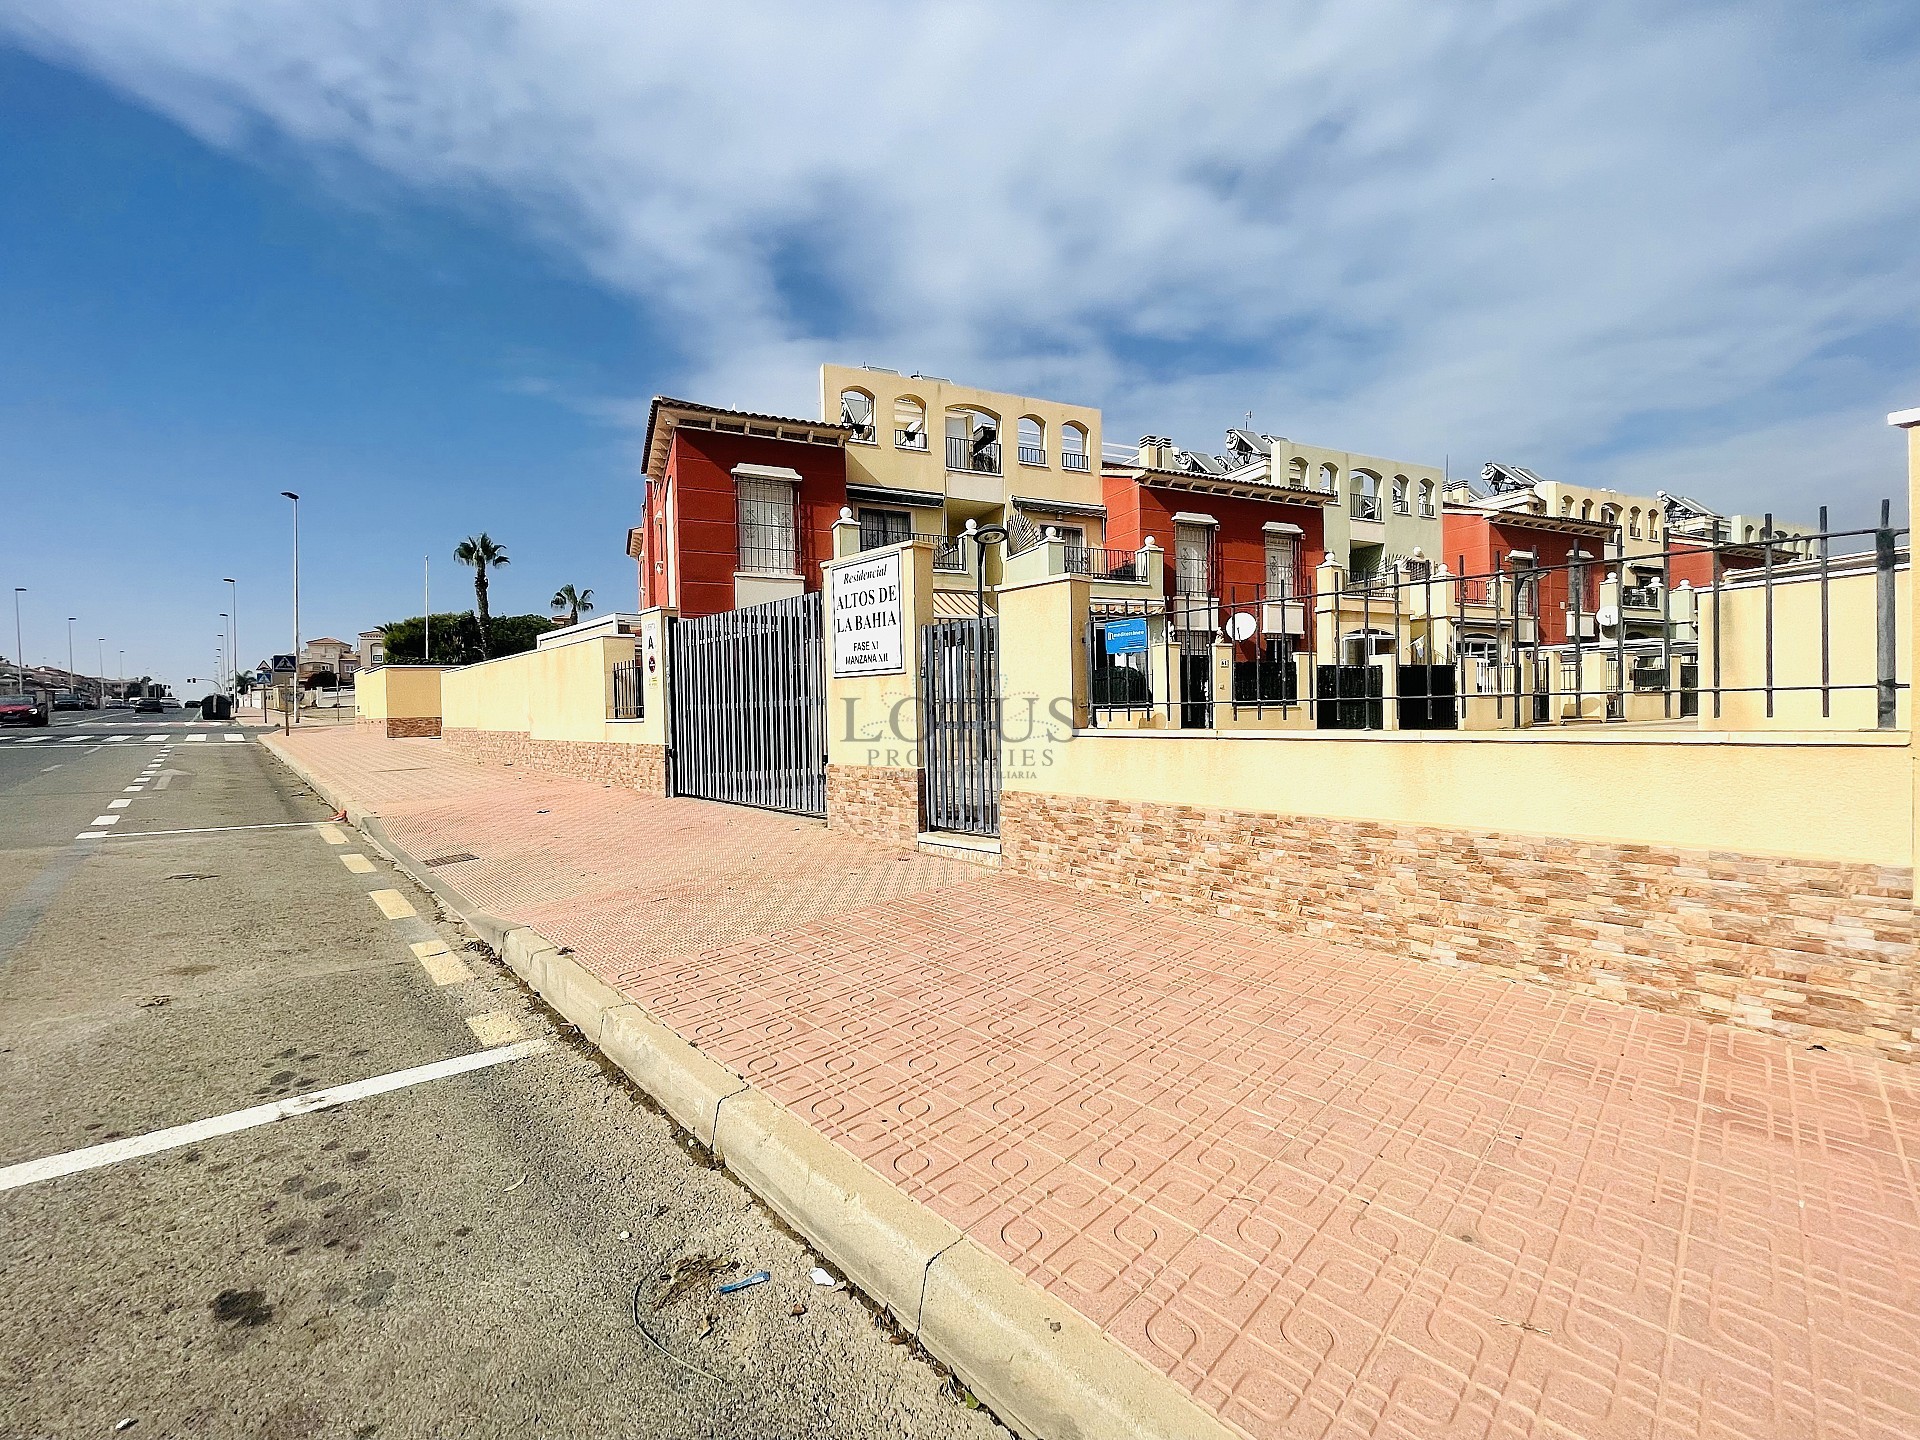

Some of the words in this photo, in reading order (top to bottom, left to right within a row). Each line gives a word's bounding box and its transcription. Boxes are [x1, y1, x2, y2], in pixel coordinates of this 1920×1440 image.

[843, 563, 888, 585] Residencial
[836, 589, 875, 611] ALTOS
[878, 584, 897, 604] DE
[836, 617, 853, 633] LA
[855, 610, 897, 631] BAHIA
[648, 636, 654, 649] A
[853, 640, 870, 652] FASE
[871, 640, 879, 651] XI
[845, 653, 878, 666] MANZANA
